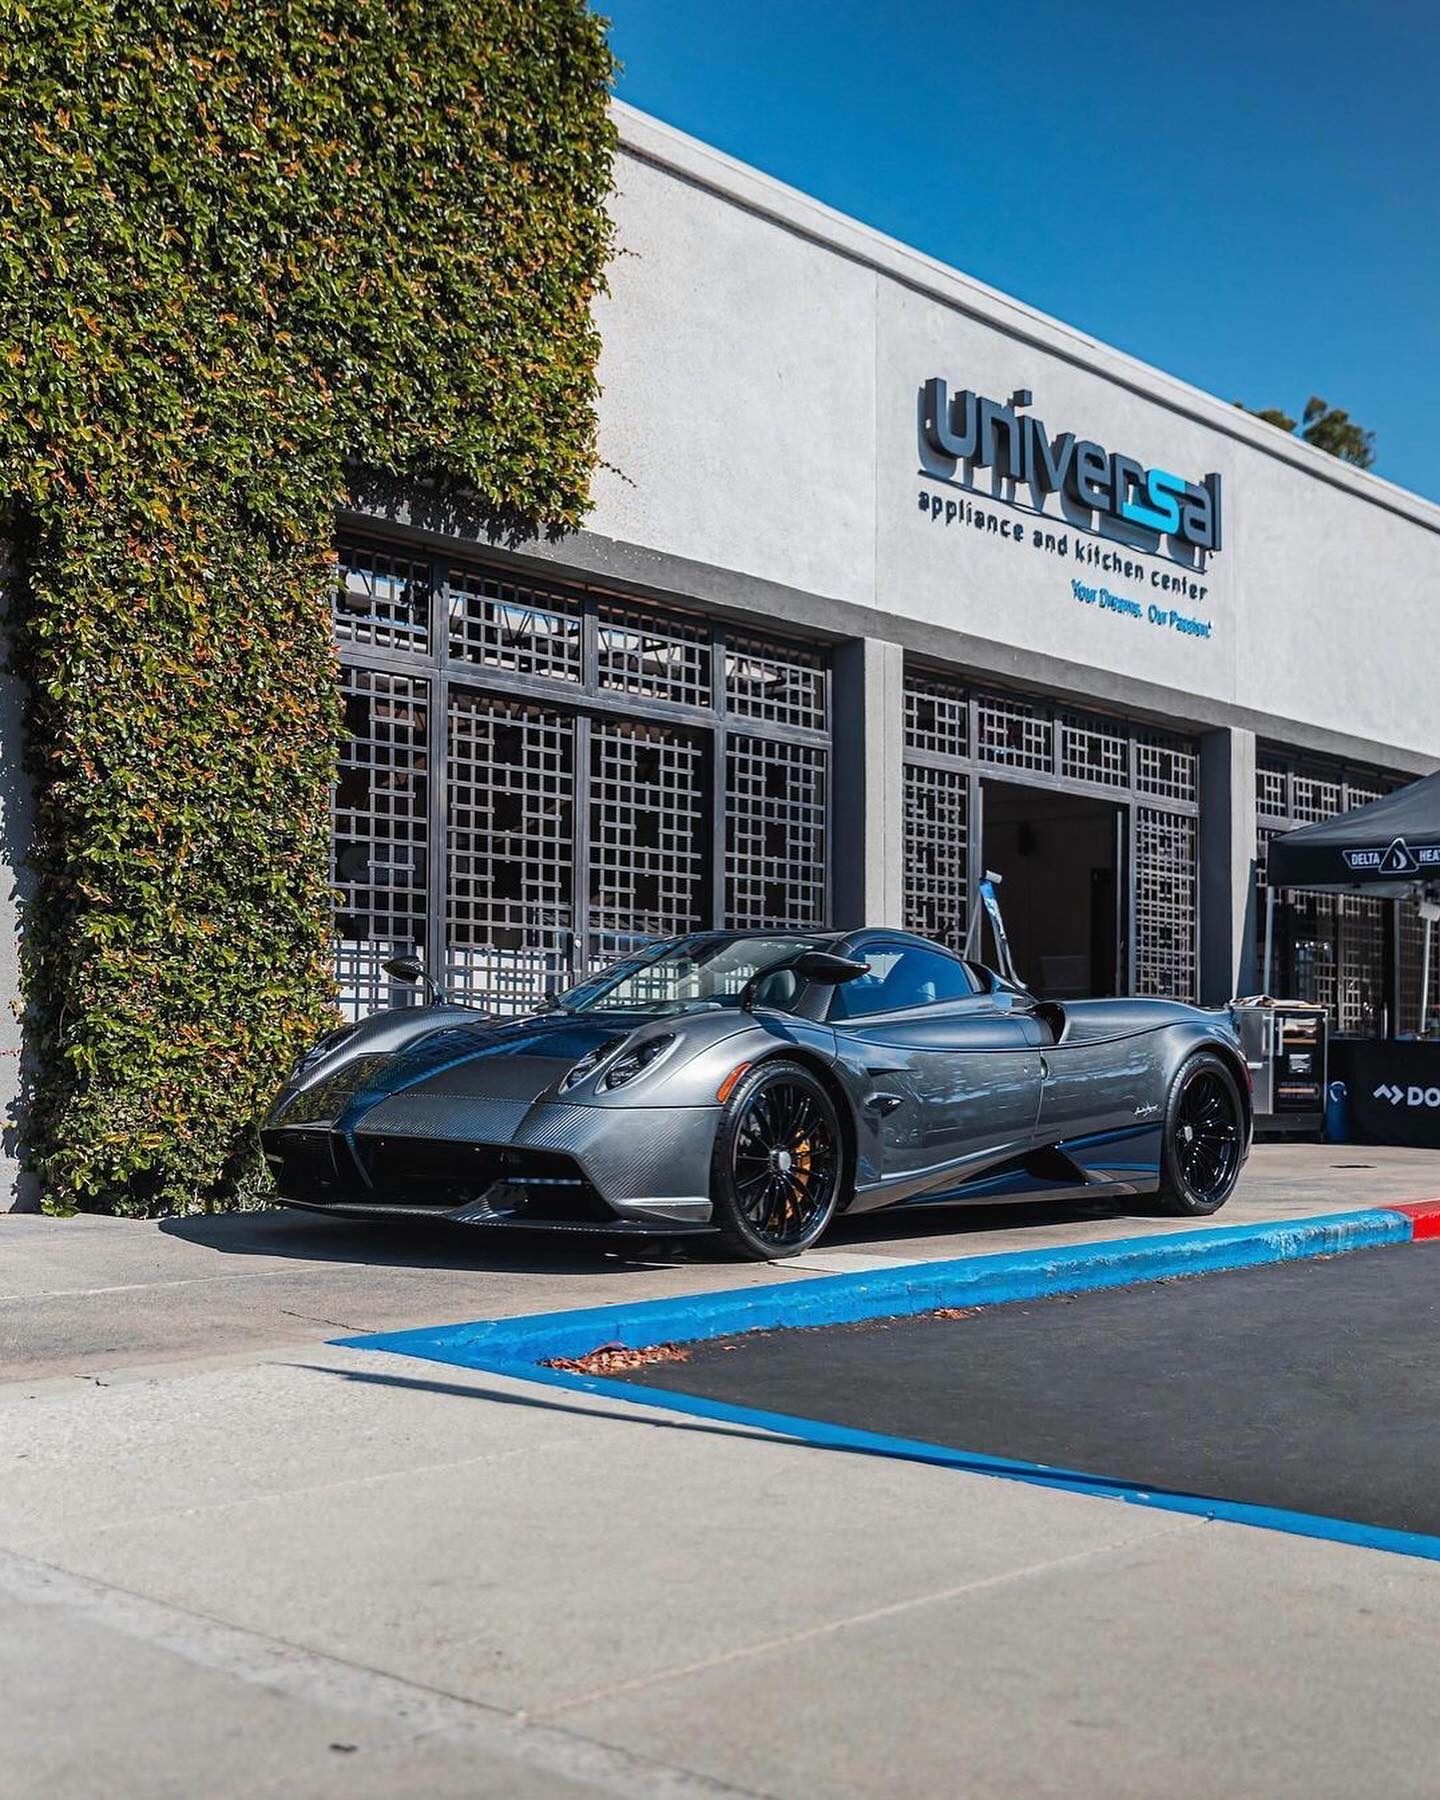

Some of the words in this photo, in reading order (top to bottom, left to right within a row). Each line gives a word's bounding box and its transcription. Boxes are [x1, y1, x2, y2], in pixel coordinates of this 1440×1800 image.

[922, 377, 1222, 551] universal
[918, 490, 1024, 542] appliance
[1033, 528, 1068, 556] and
[1075, 539, 1144, 581] kitchen
[1151, 570, 1208, 601] center
[1071, 578, 1097, 604] Your
[1148, 604, 1168, 626] Our
[1351, 853, 1380, 865] DELTA
